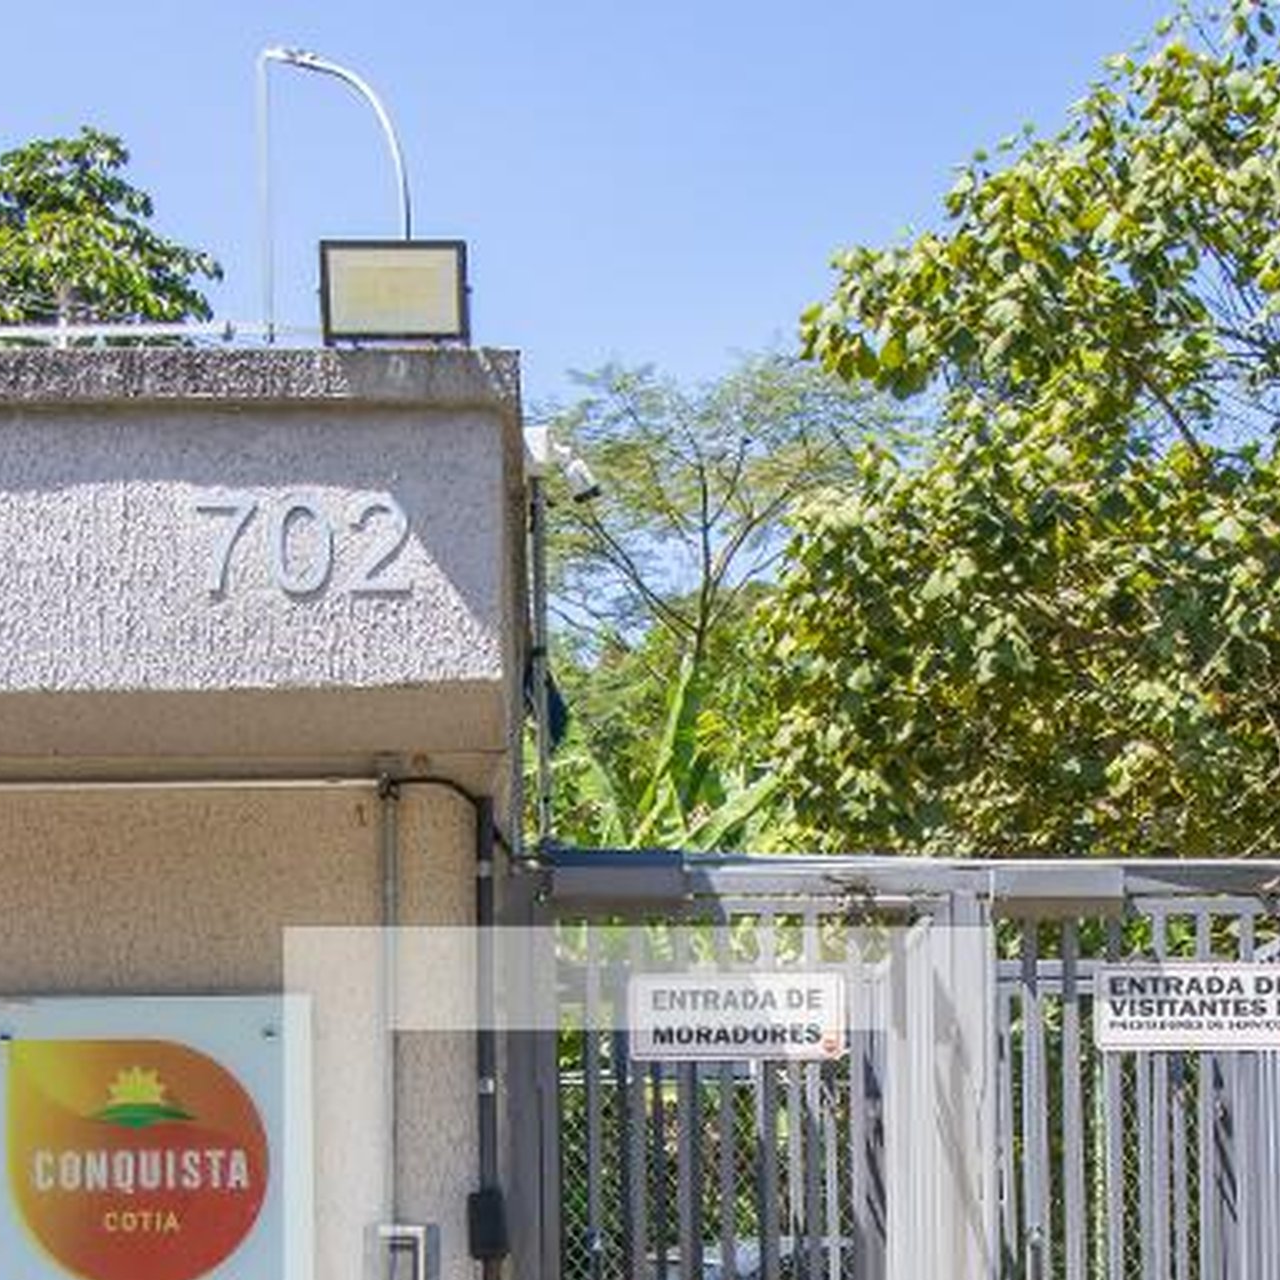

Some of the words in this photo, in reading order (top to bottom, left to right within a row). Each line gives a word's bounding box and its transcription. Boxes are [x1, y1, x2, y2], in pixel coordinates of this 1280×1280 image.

[193, 491, 413, 602] 702
[1110, 976, 1244, 996] ENTRADA
[651, 989, 777, 1011] ENTRADA
[787, 988, 823, 1010] DE
[1109, 998, 1267, 1017] VISITANTES
[651, 1025, 822, 1045] MORADORES
[34, 1149, 249, 1194] CONQUISTA
[104, 1211, 180, 1232] COTIA
